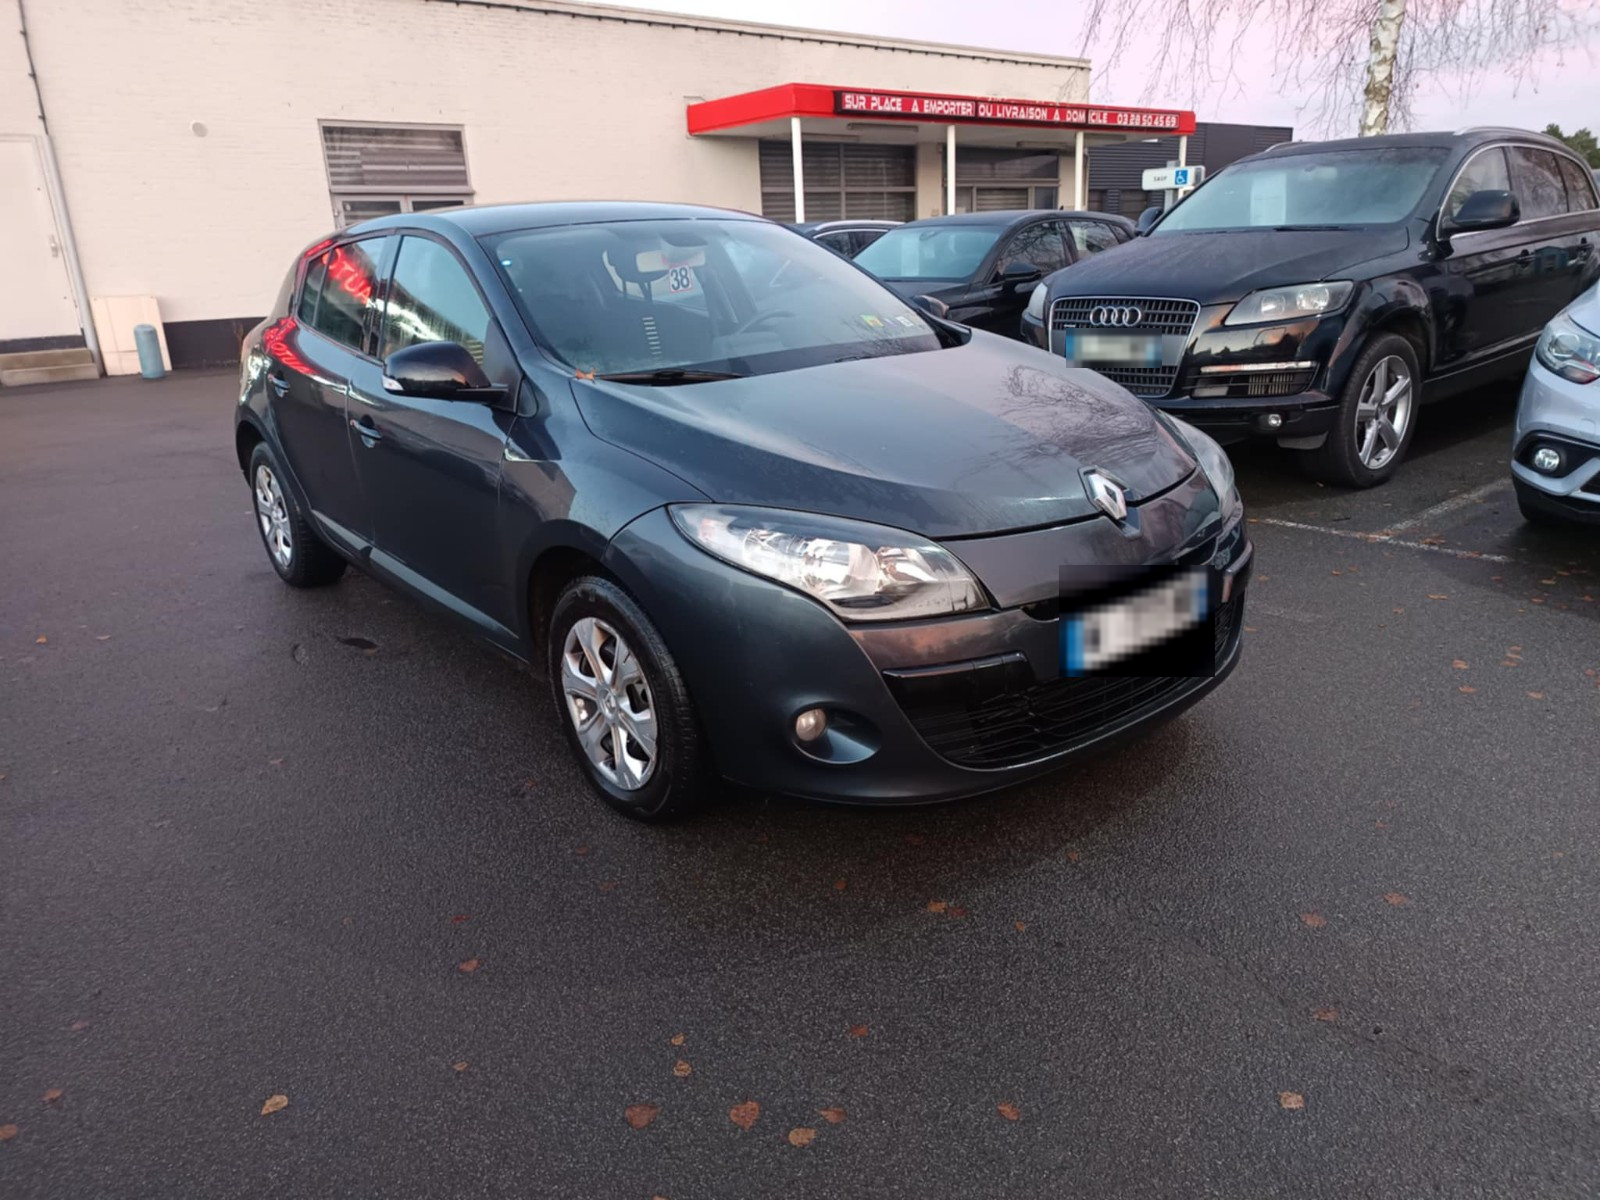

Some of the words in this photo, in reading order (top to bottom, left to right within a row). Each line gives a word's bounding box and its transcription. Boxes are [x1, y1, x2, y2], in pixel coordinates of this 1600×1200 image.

[844, 94, 866, 110] SUR
[871, 96, 902, 112] PLACE
[911, 99, 920, 113] A
[923, 99, 973, 117] EMPORTER
[978, 103, 993, 117] OU
[996, 105, 1048, 120] LIVRAISON
[1053, 108, 1060, 121] A
[670, 266, 690, 291] 38
